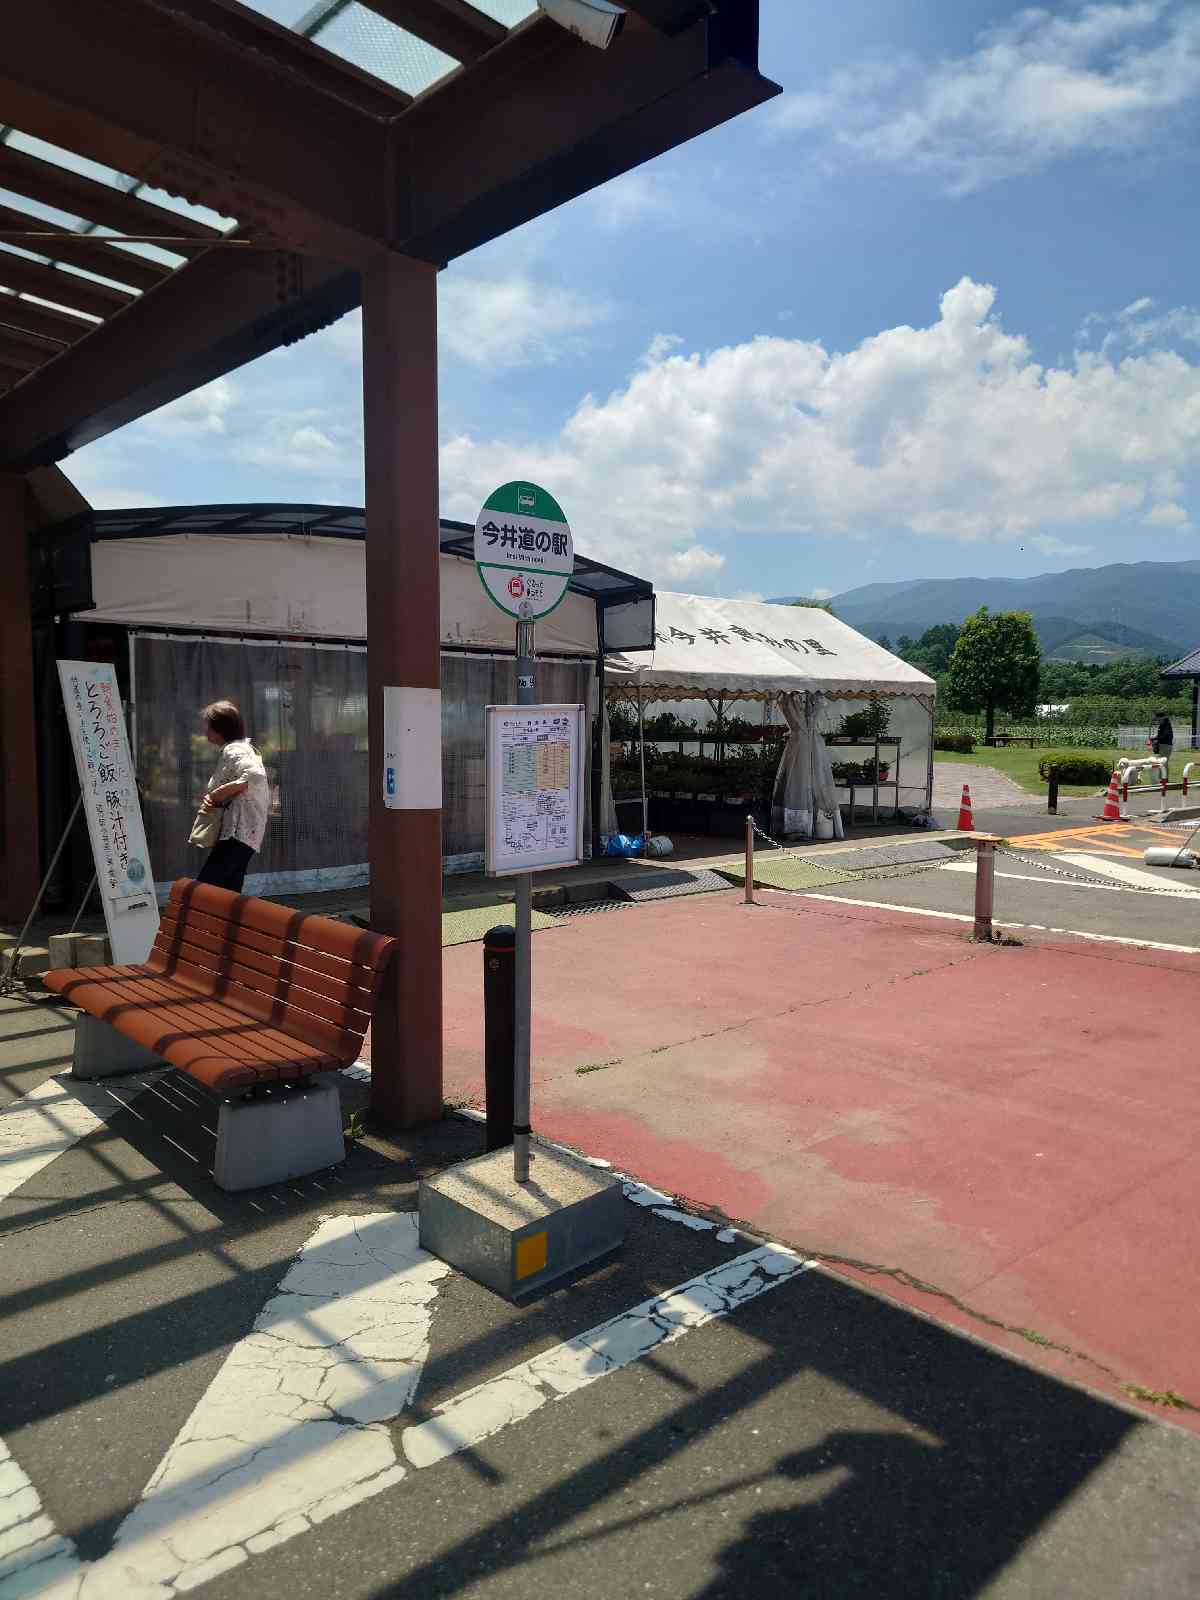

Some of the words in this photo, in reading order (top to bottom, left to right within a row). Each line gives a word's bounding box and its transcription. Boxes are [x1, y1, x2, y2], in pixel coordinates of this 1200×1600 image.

[481, 521, 568, 557] 今井道の駅
[85, 681, 118, 784] とろろご飯
[105, 791, 129, 871] 豚汁付き
